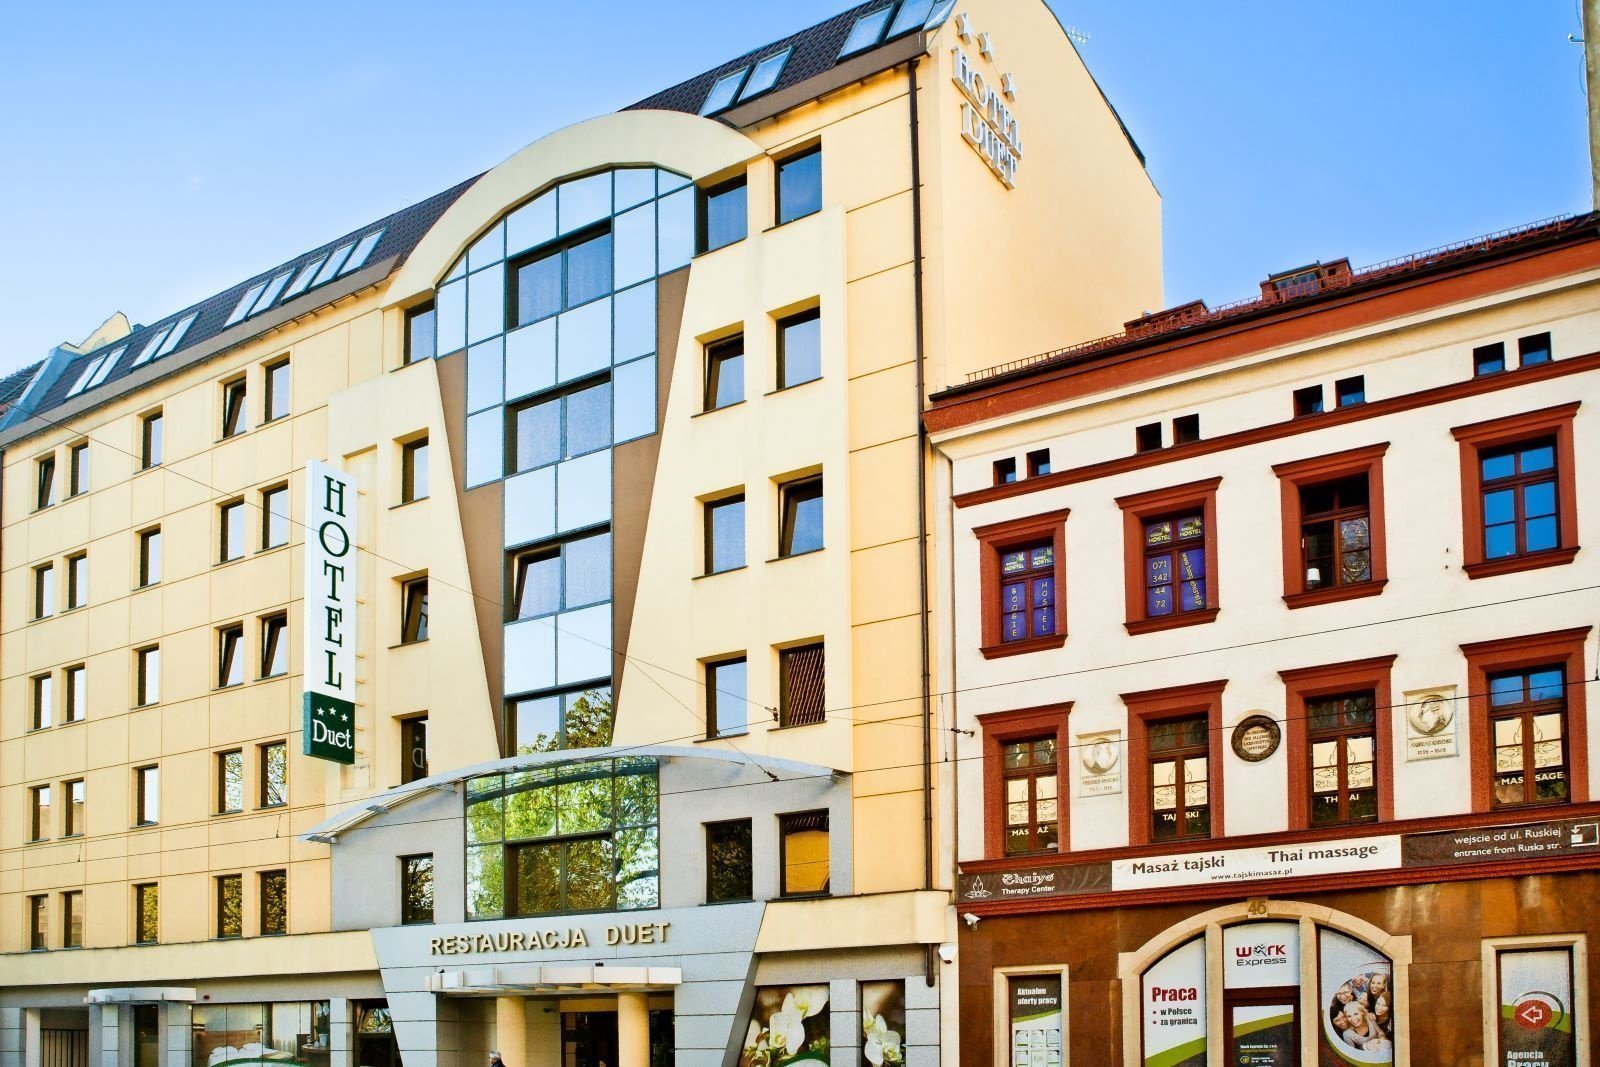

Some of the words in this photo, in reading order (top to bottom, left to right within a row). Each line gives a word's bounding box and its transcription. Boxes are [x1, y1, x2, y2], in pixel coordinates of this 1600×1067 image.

[951, 47, 1022, 159] HOTEL
[960, 102, 1017, 190] DUET
[1152, 561, 1168, 570] 071
[319, 475, 350, 690] HOTEL
[1152, 573, 1168, 583] 342
[1155, 587, 1166, 595] 44
[1155, 600, 1166, 608] 72
[312, 719, 353, 751] Duet
[1454, 834, 1491, 846] wejscie
[1493, 832, 1507, 841] od
[1510, 830, 1522, 840] ul.
[1525, 827, 1561, 839] Ruskiej
[1269, 848, 1303, 863] Thai
[1308, 844, 1378, 861] massage
[1454, 847, 1491, 857] entrance
[1493, 846, 1516, 855] from
[1518, 843, 1544, 852] Ruska
[1132, 858, 1180, 875] Masaż
[1184, 855, 1225, 874] tajski
[1211, 867, 1293, 881] www.tajskimasaz.pl
[1031, 885, 1055, 893] Center
[1248, 901, 1267, 915] 46
[430, 927, 589, 955] RESTAURACJA
[604, 922, 671, 946] DUET
[1236, 957, 1287, 967] Express
[1017, 988, 1047, 996] Aktualne
[1152, 986, 1197, 1002] Praca
[1017, 998, 1037, 1006] oferty
[1038, 997, 1058, 1006] pracy
[1168, 1007, 1193, 1016] Polsce
[1160, 1019, 1168, 1027] za
[1507, 1049, 1544, 1060] Agencja
